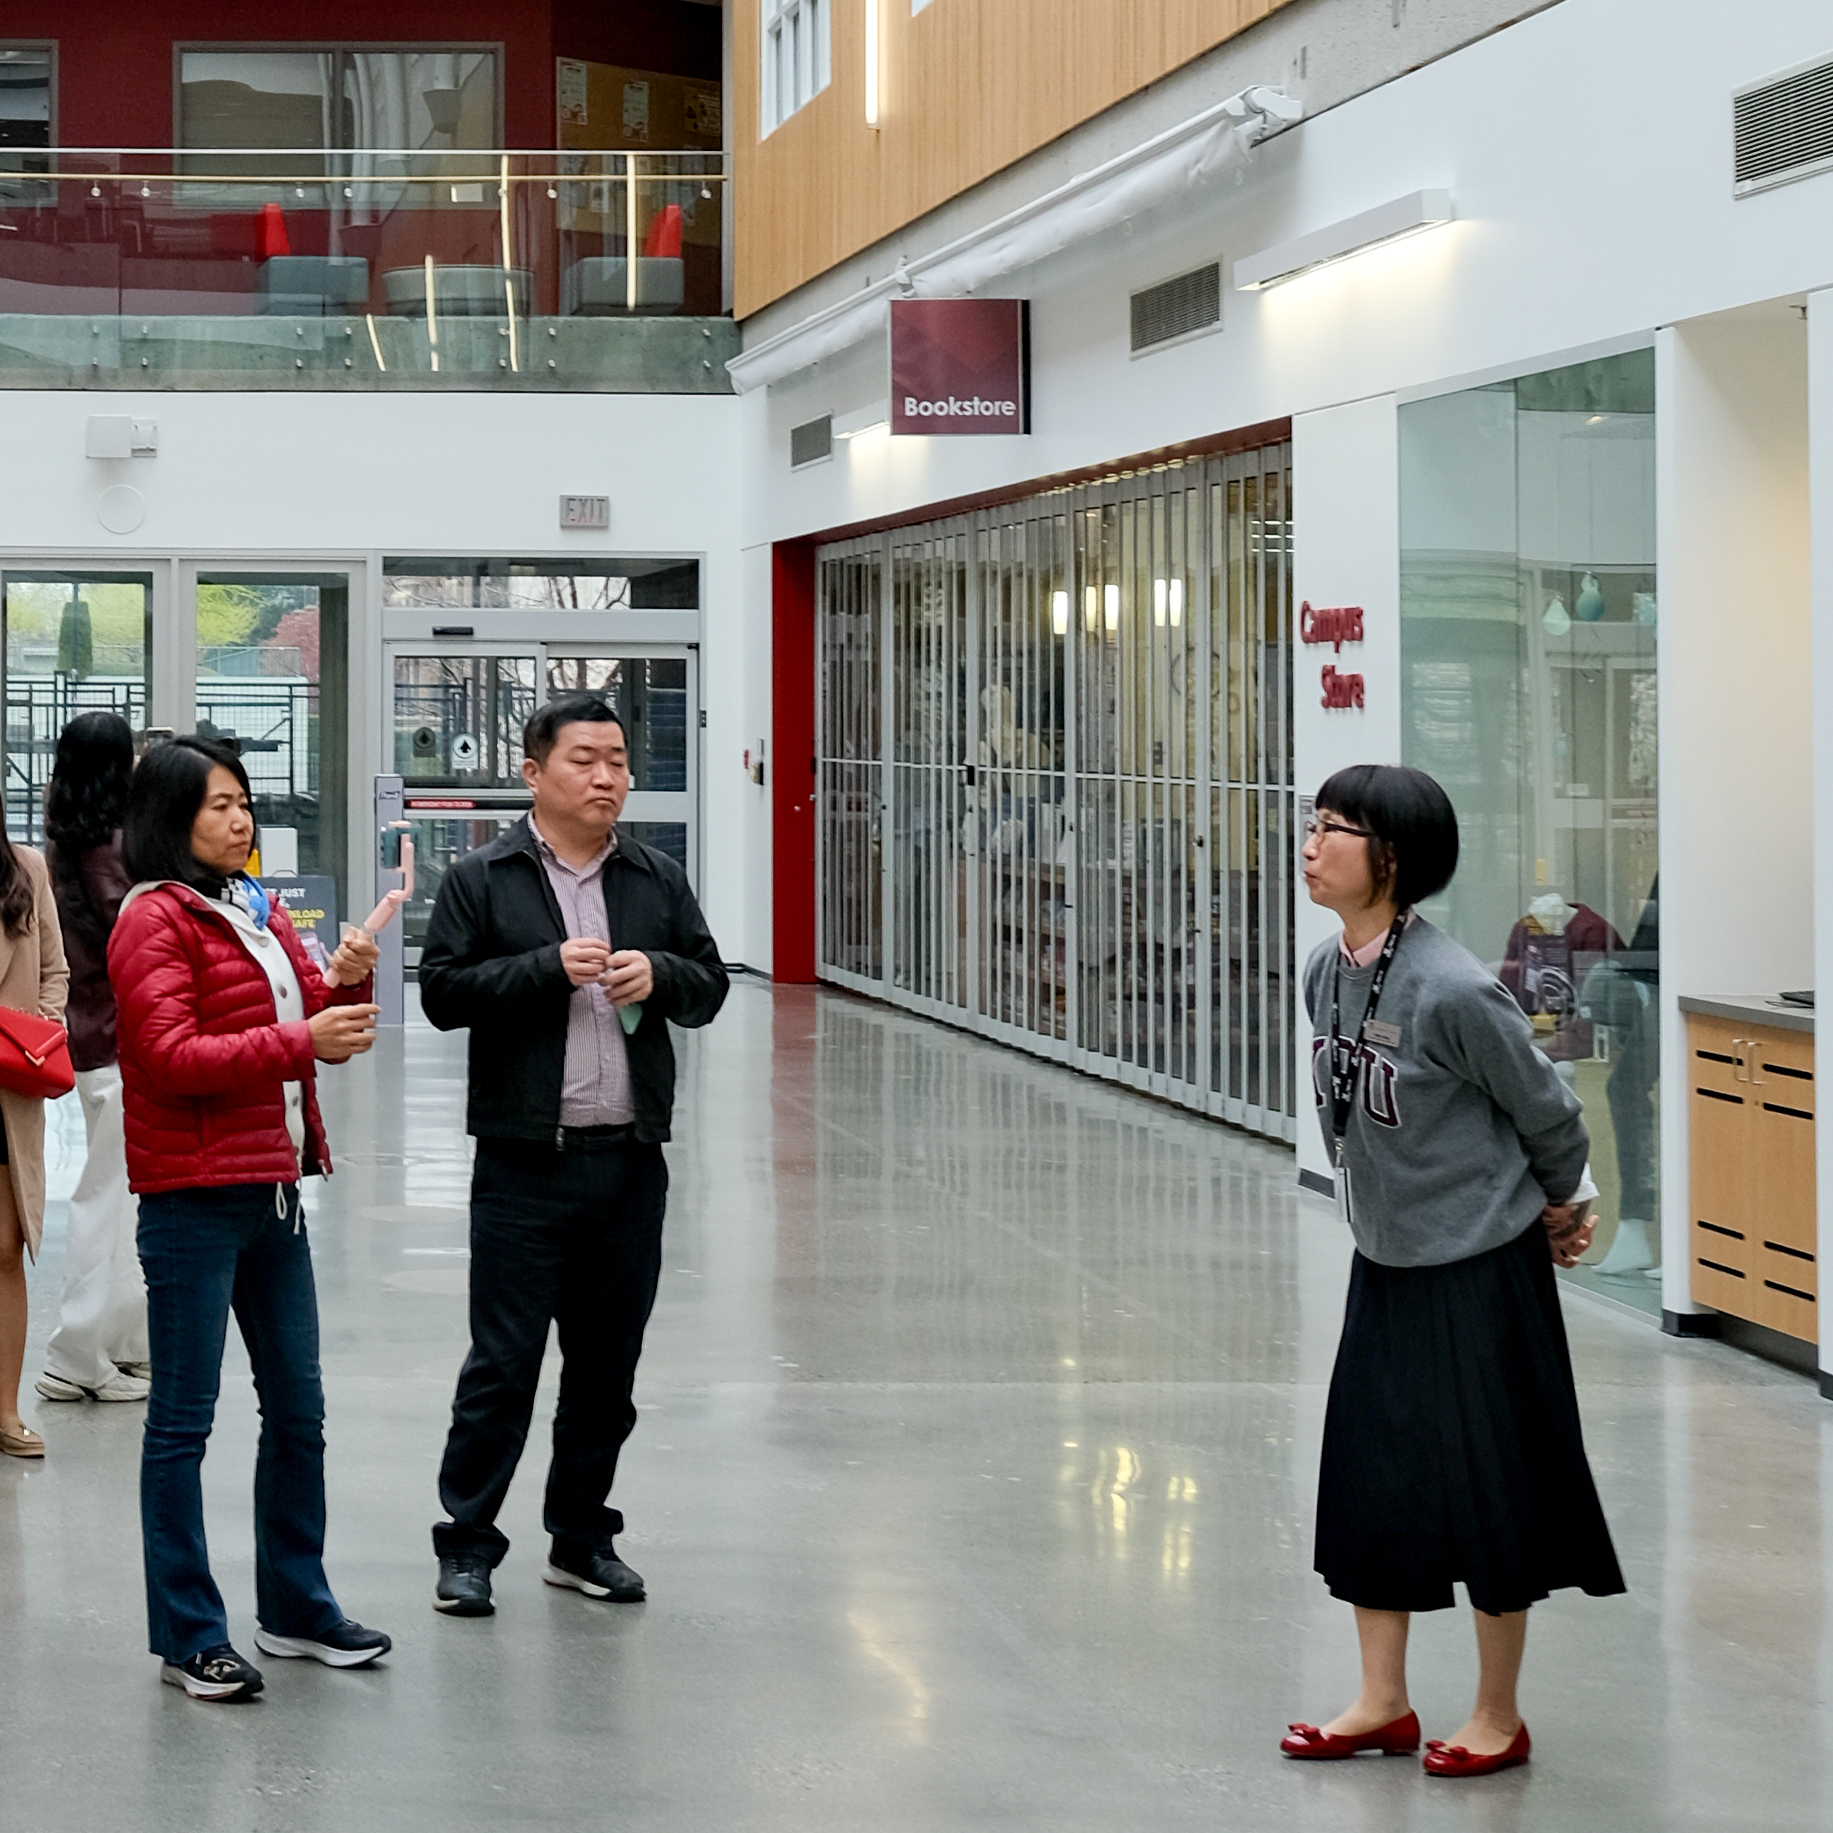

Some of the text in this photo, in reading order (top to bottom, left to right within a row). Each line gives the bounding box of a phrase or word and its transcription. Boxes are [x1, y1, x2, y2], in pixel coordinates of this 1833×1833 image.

[904, 396, 1016, 417] Bookstore
[565, 498, 606, 524] EXIT
[1300, 601, 1363, 654] Campus
[1321, 665, 1363, 709] Store
[279, 887, 306, 898] JUST
